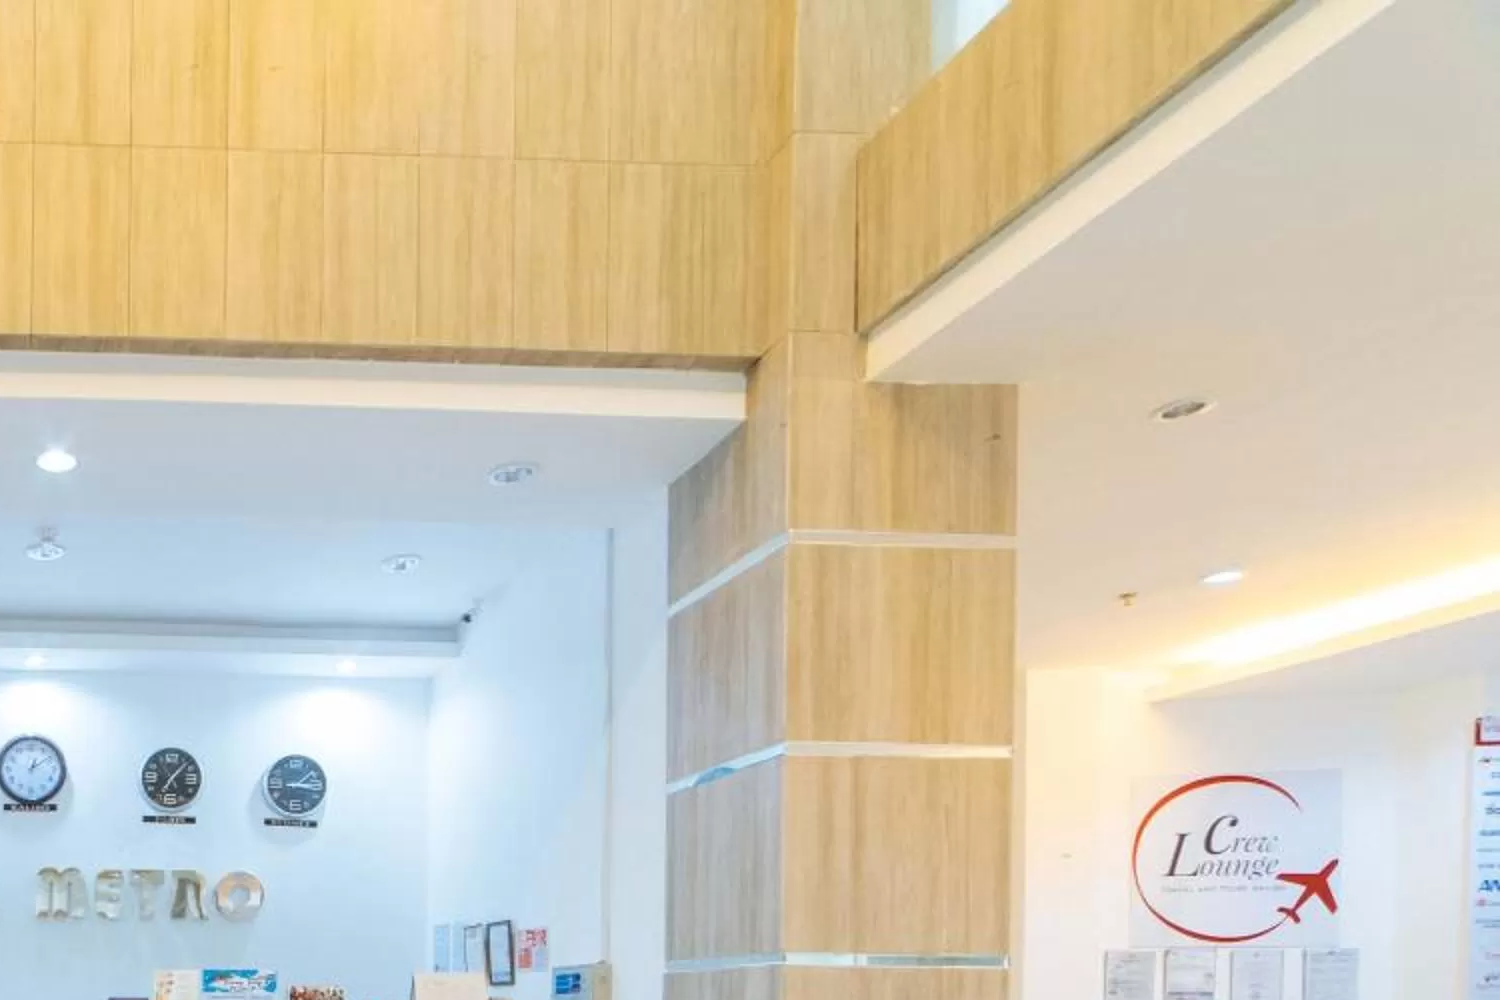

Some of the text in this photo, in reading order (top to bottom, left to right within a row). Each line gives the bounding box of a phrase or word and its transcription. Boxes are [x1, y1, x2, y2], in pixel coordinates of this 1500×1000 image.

[1162, 832, 1279, 880] Lounge
[1204, 814, 1278, 855] Crew
[35, 865, 265, 921] METRO
